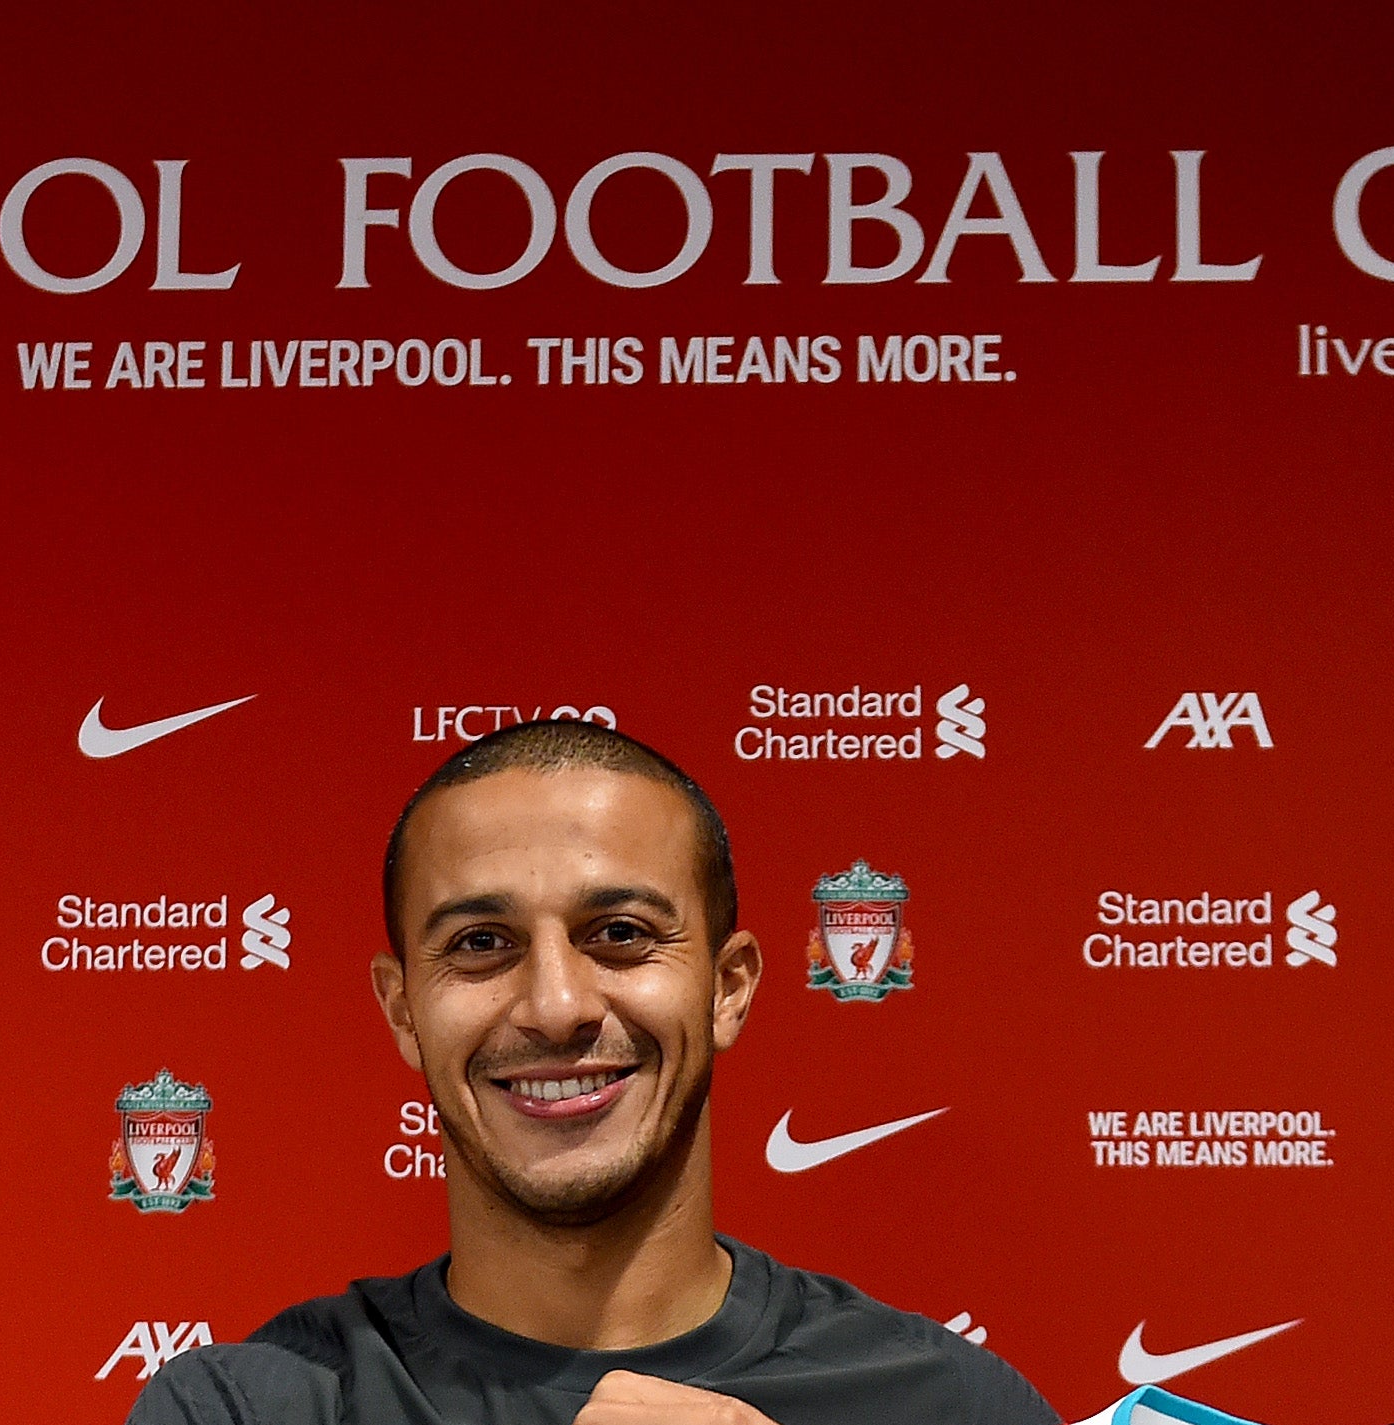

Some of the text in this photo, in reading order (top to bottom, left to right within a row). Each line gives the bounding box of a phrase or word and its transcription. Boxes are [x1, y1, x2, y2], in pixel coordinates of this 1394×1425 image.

[335, 150, 1263, 290] FOOTBALL
[17, 335, 1016, 389] WE ARE LIVERPOOL. THIS MEANS MORE.
[750, 685, 921, 718] Standard
[1143, 692, 1274, 749] AXA
[735, 727, 921, 760] Chartered
[57, 895, 227, 929] Standard
[826, 912, 895, 926] LIVERPOOL
[1098, 891, 1271, 926] Standard
[41, 937, 226, 971] Chartered
[1083, 934, 1272, 968] Chartered
[129, 1123, 199, 1137] LIVERPOOL
[1088, 1111, 1336, 1138] WE ARE LIVERPOOL.
[1090, 1140, 1334, 1168] THIS MEANS MORE.
